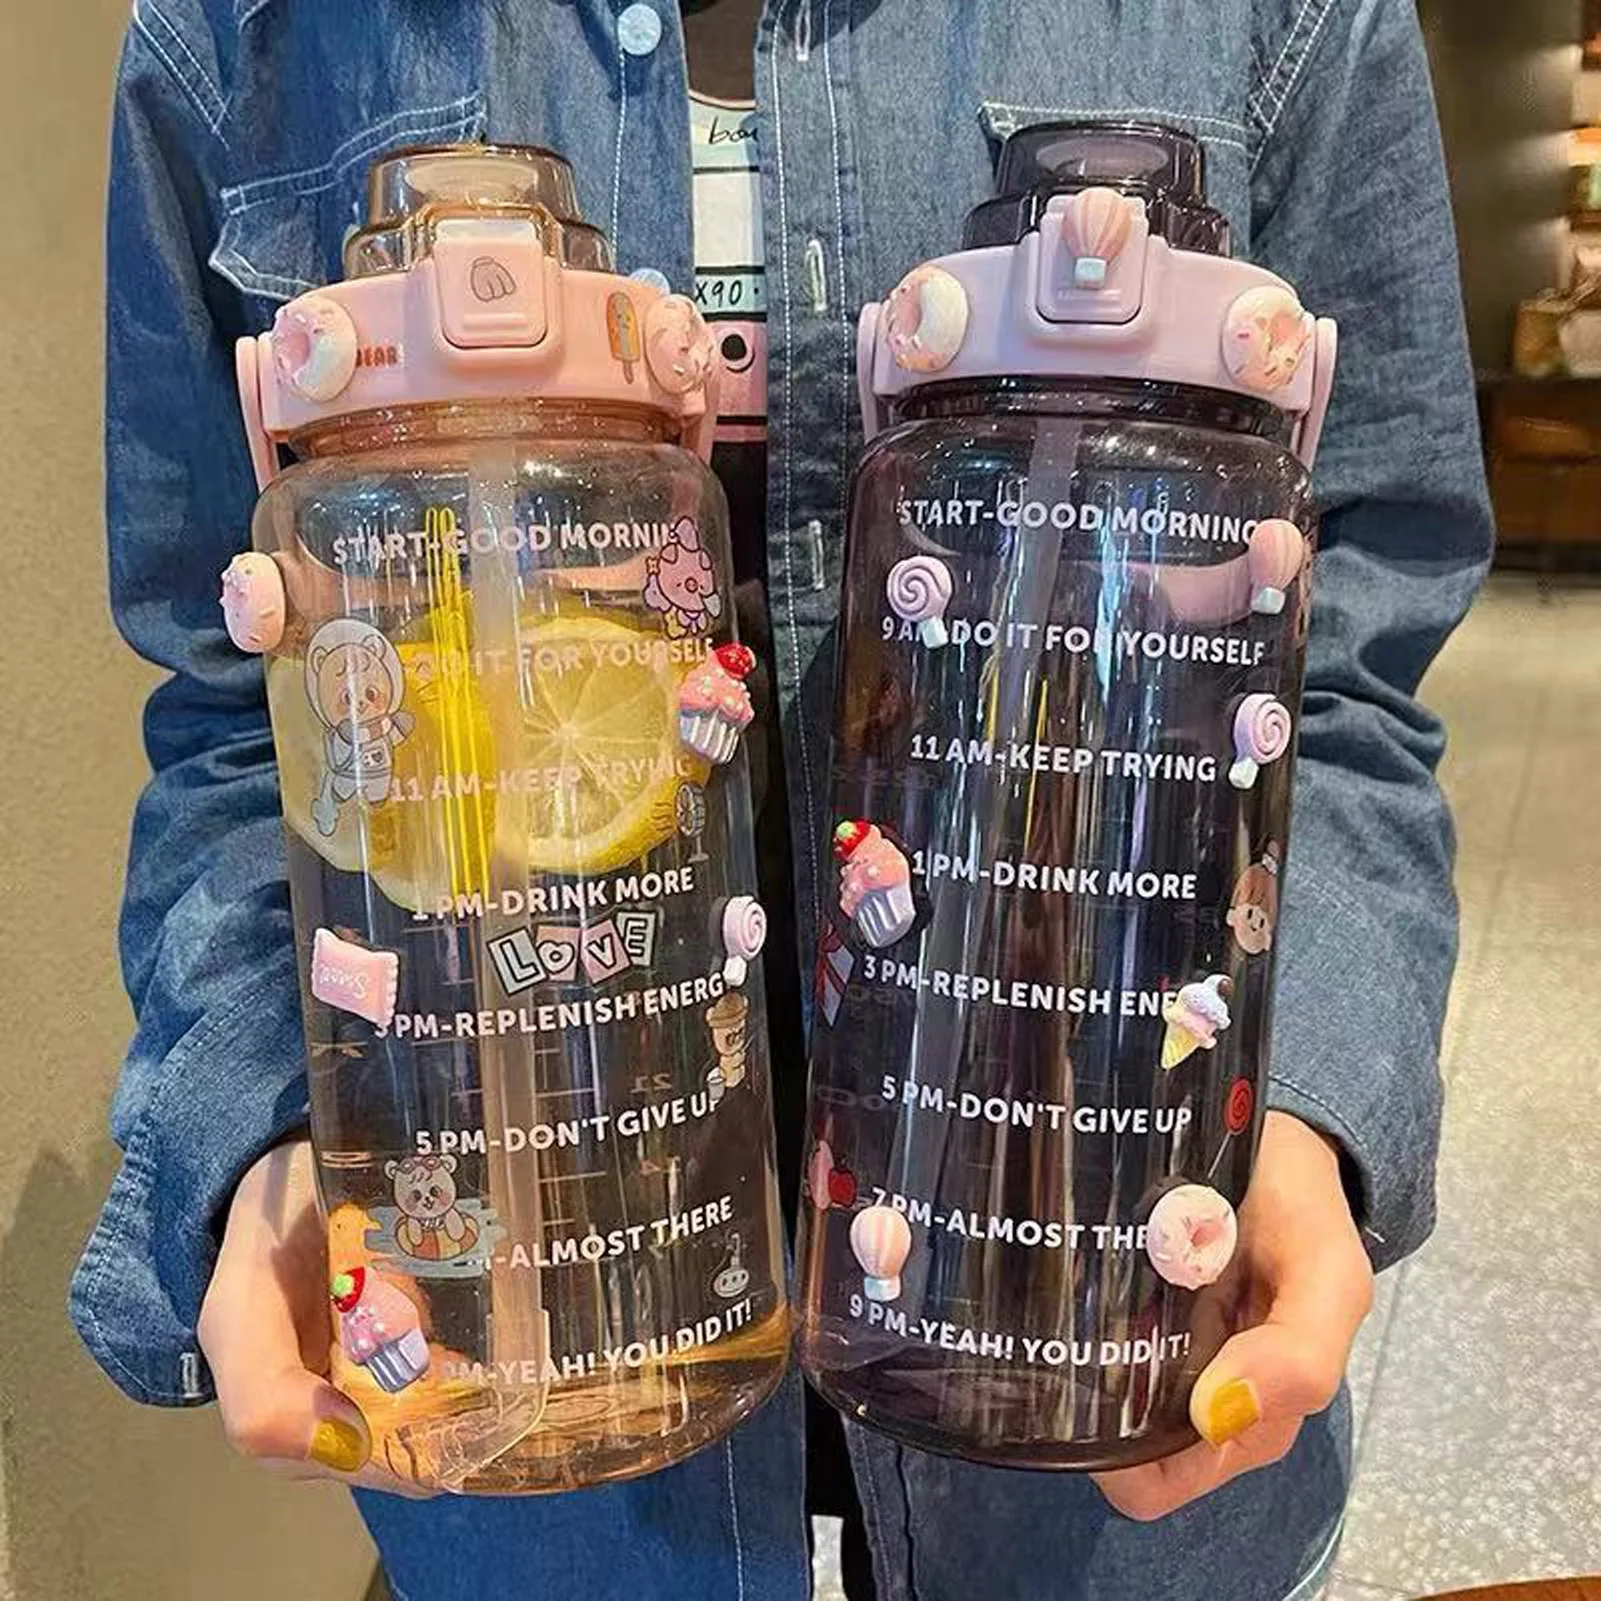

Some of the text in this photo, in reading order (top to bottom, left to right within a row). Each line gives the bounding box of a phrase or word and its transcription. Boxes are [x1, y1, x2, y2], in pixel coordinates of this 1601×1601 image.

[898, 499, 1102, 530] START-GOOD
[332, 524, 551, 565] START-GOOD
[881, 615, 895, 641] 9
[1007, 623, 1038, 649] IT
[1121, 630, 1265, 666] YOURSELF
[390, 777, 424, 801] 11
[432, 766, 581, 801] AM-KEEP
[910, 733, 1217, 782] 11 AM-KEEP TRYING
[435, 878, 609, 920] PM-DRINK
[615, 866, 695, 904] MORE
[911, 850, 1198, 900] 1 PM-DRINK MORE
[500, 914, 650, 985] LOVE
[395, 990, 636, 1039] PM-REPLENISH
[644, 971, 724, 1017] ENERG
[863, 954, 876, 979] 3
[881, 961, 1110, 1015] PM-REPLENISH
[415, 1130, 430, 1156] 5
[440, 1115, 610, 1156] PM-DON'T
[616, 1098, 686, 1138] GIVE
[881, 1075, 896, 1101] 5
[902, 1080, 1067, 1130] PM-DON'T
[1073, 1106, 1149, 1134] GIVE
[1155, 1106, 1192, 1134] UP
[485, 1195, 733, 1271] -ALMOST THERE
[891, 1192, 1085, 1250] PM-ALMOST
[1093, 1223, 1149, 1251] THE
[602, 1333, 669, 1373] YOU
[675, 1314, 723, 1352] DID
[725, 1297, 752, 1334] IT!
[849, 1294, 1191, 1367] 9 PM-YEAH! YOU DID IT!
